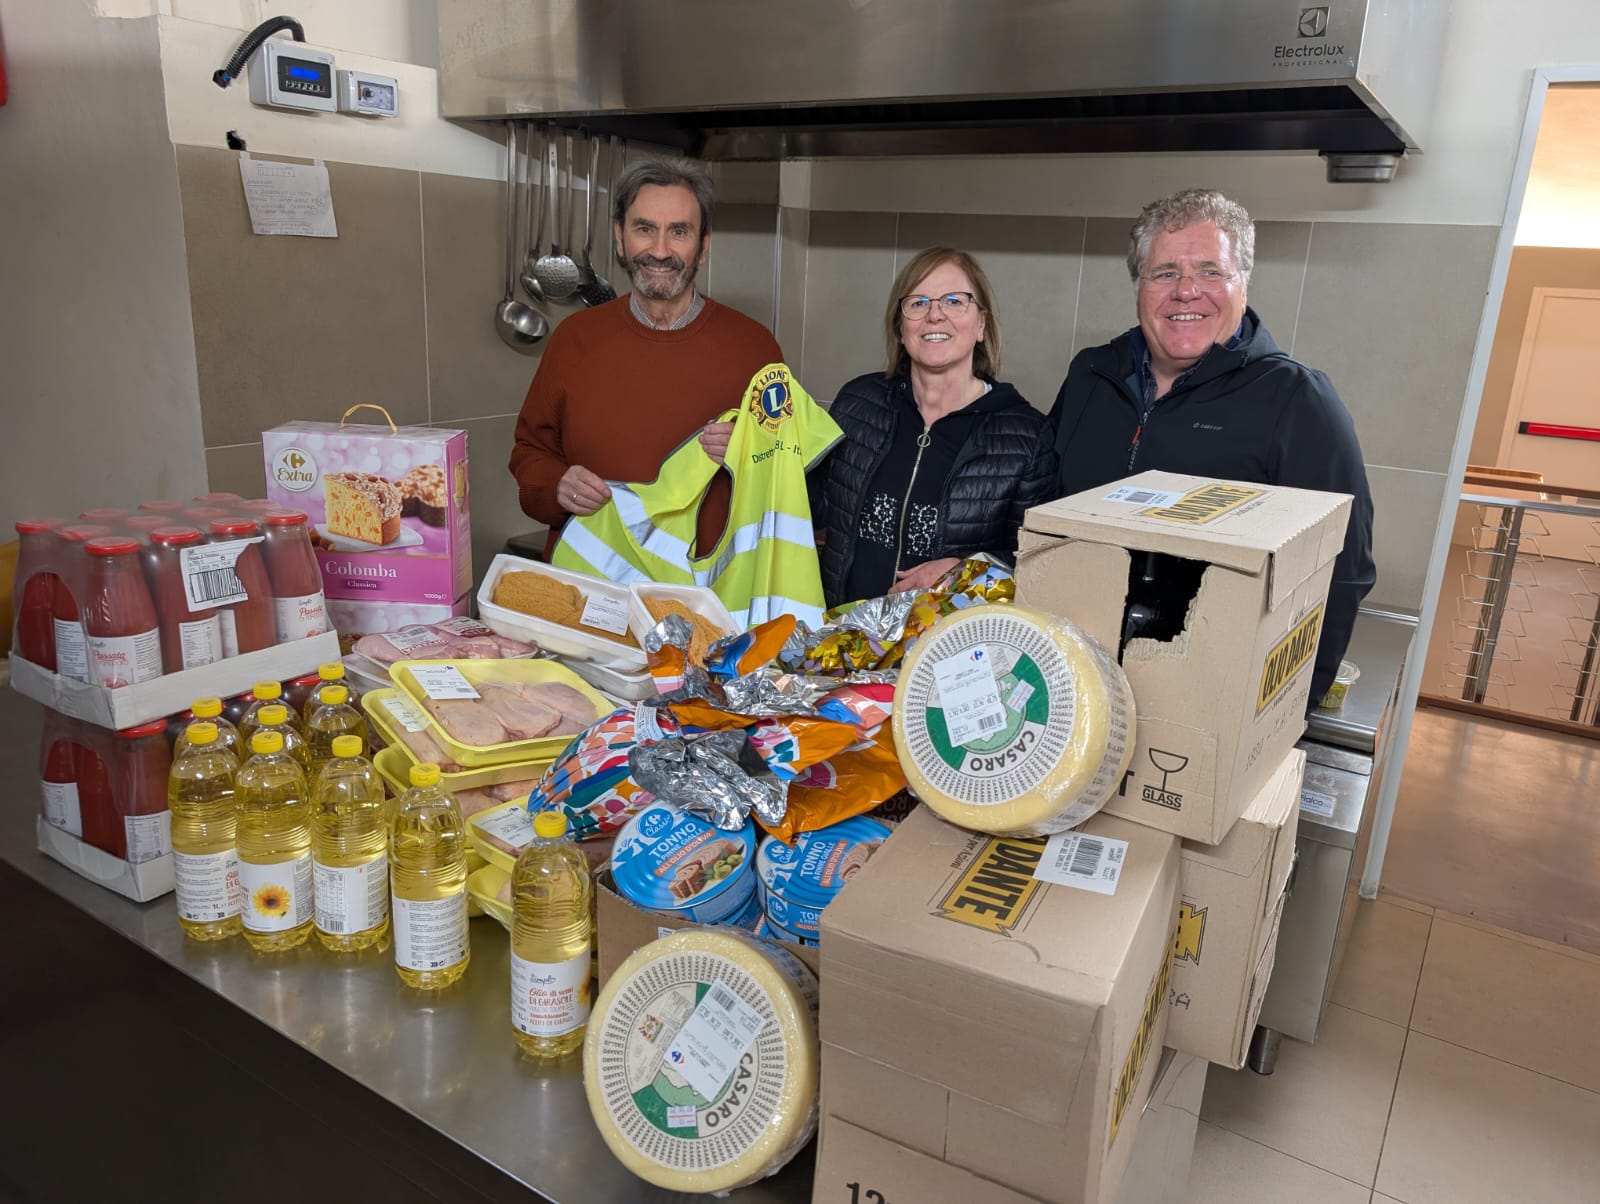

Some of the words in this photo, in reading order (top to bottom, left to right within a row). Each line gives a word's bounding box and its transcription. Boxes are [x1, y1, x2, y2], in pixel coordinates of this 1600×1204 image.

[1274, 44, 1344, 58] Electrolux
[1272, 59, 1343, 68] PROFESSIONAL
[767, 387, 782, 413] L
[752, 448, 776, 464] Distrett
[278, 468, 314, 482] Extra
[325, 560, 398, 578] Colomba
[347, 580, 377, 589] Classica
[1263, 642, 1289, 702] OLIO
[1284, 612, 1320, 677] DANTE
[970, 730, 1035, 772] CASARO
[1142, 787, 1182, 809] GLASS
[649, 822, 697, 858] TONNO
[800, 841, 826, 876] TONNO
[951, 850, 970, 871] Azioni
[954, 842, 1043, 920] DANTE
[530, 997, 536, 1005] DI
[706, 1052, 754, 1127] CASARO
